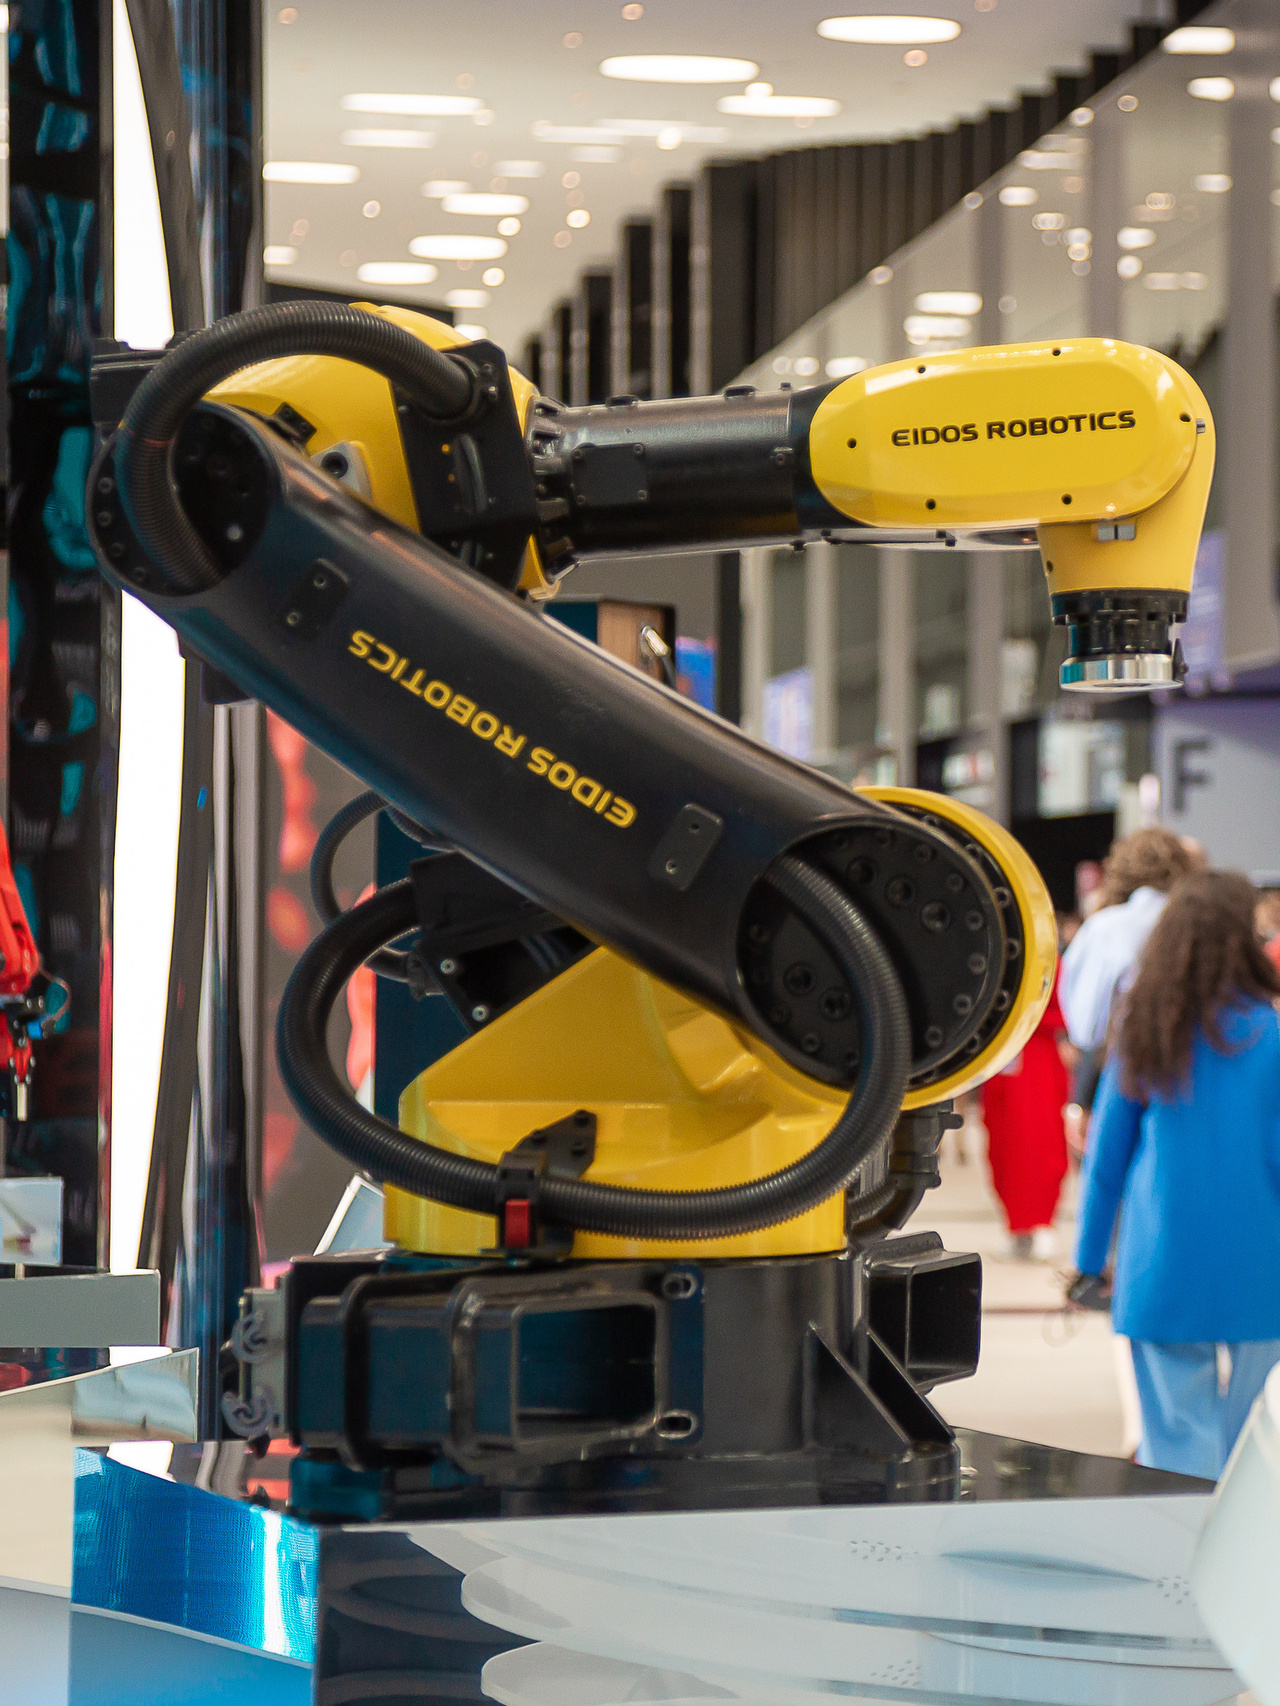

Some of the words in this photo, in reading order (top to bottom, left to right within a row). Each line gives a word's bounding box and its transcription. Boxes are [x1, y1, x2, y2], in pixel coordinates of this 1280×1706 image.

[891, 422, 979, 447] EIDOS
[986, 409, 1137, 440] ROBOTICS
[347, 629, 528, 759] ROBOTICS
[526, 746, 638, 829] EIDOS
[1174, 739, 1211, 814] F
